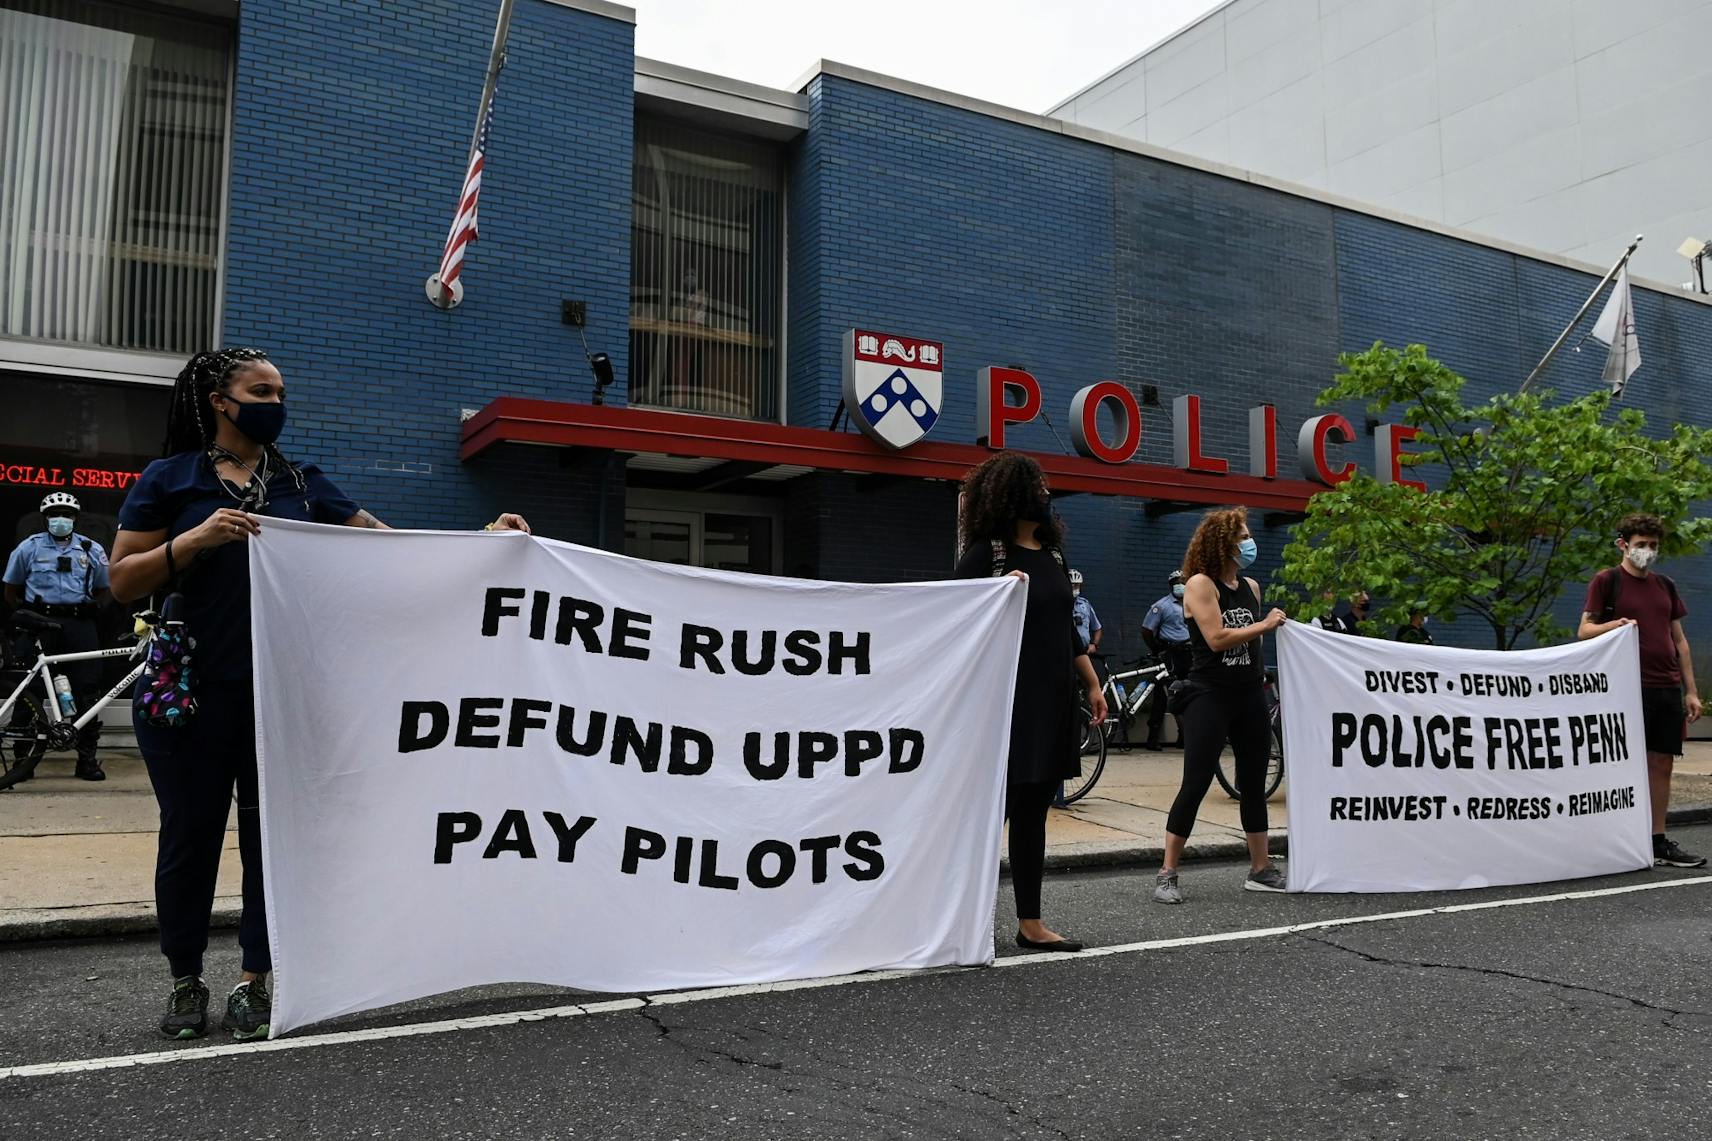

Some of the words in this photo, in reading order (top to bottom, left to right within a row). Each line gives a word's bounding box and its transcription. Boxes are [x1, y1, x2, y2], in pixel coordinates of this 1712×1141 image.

[978, 365, 1428, 494] POLICE
[482, 588, 651, 661] FIRE
[680, 623, 870, 676] RUSH
[1365, 670, 1438, 694] DIVEST
[1461, 673, 1531, 698] DEFUND
[1549, 671, 1608, 694] DISBAND
[398, 698, 713, 775] DEFUND
[743, 728, 924, 781] UPPD
[1332, 712, 1473, 770] POLICE
[1484, 718, 1563, 771] FREE
[1568, 713, 1628, 768] PENN
[1330, 795, 1446, 822] REINVEST
[1468, 796, 1551, 821] REDRESS
[1569, 786, 1635, 817] REIMAGINE
[434, 809, 597, 864] PAY
[621, 826, 884, 890] PILOTS
